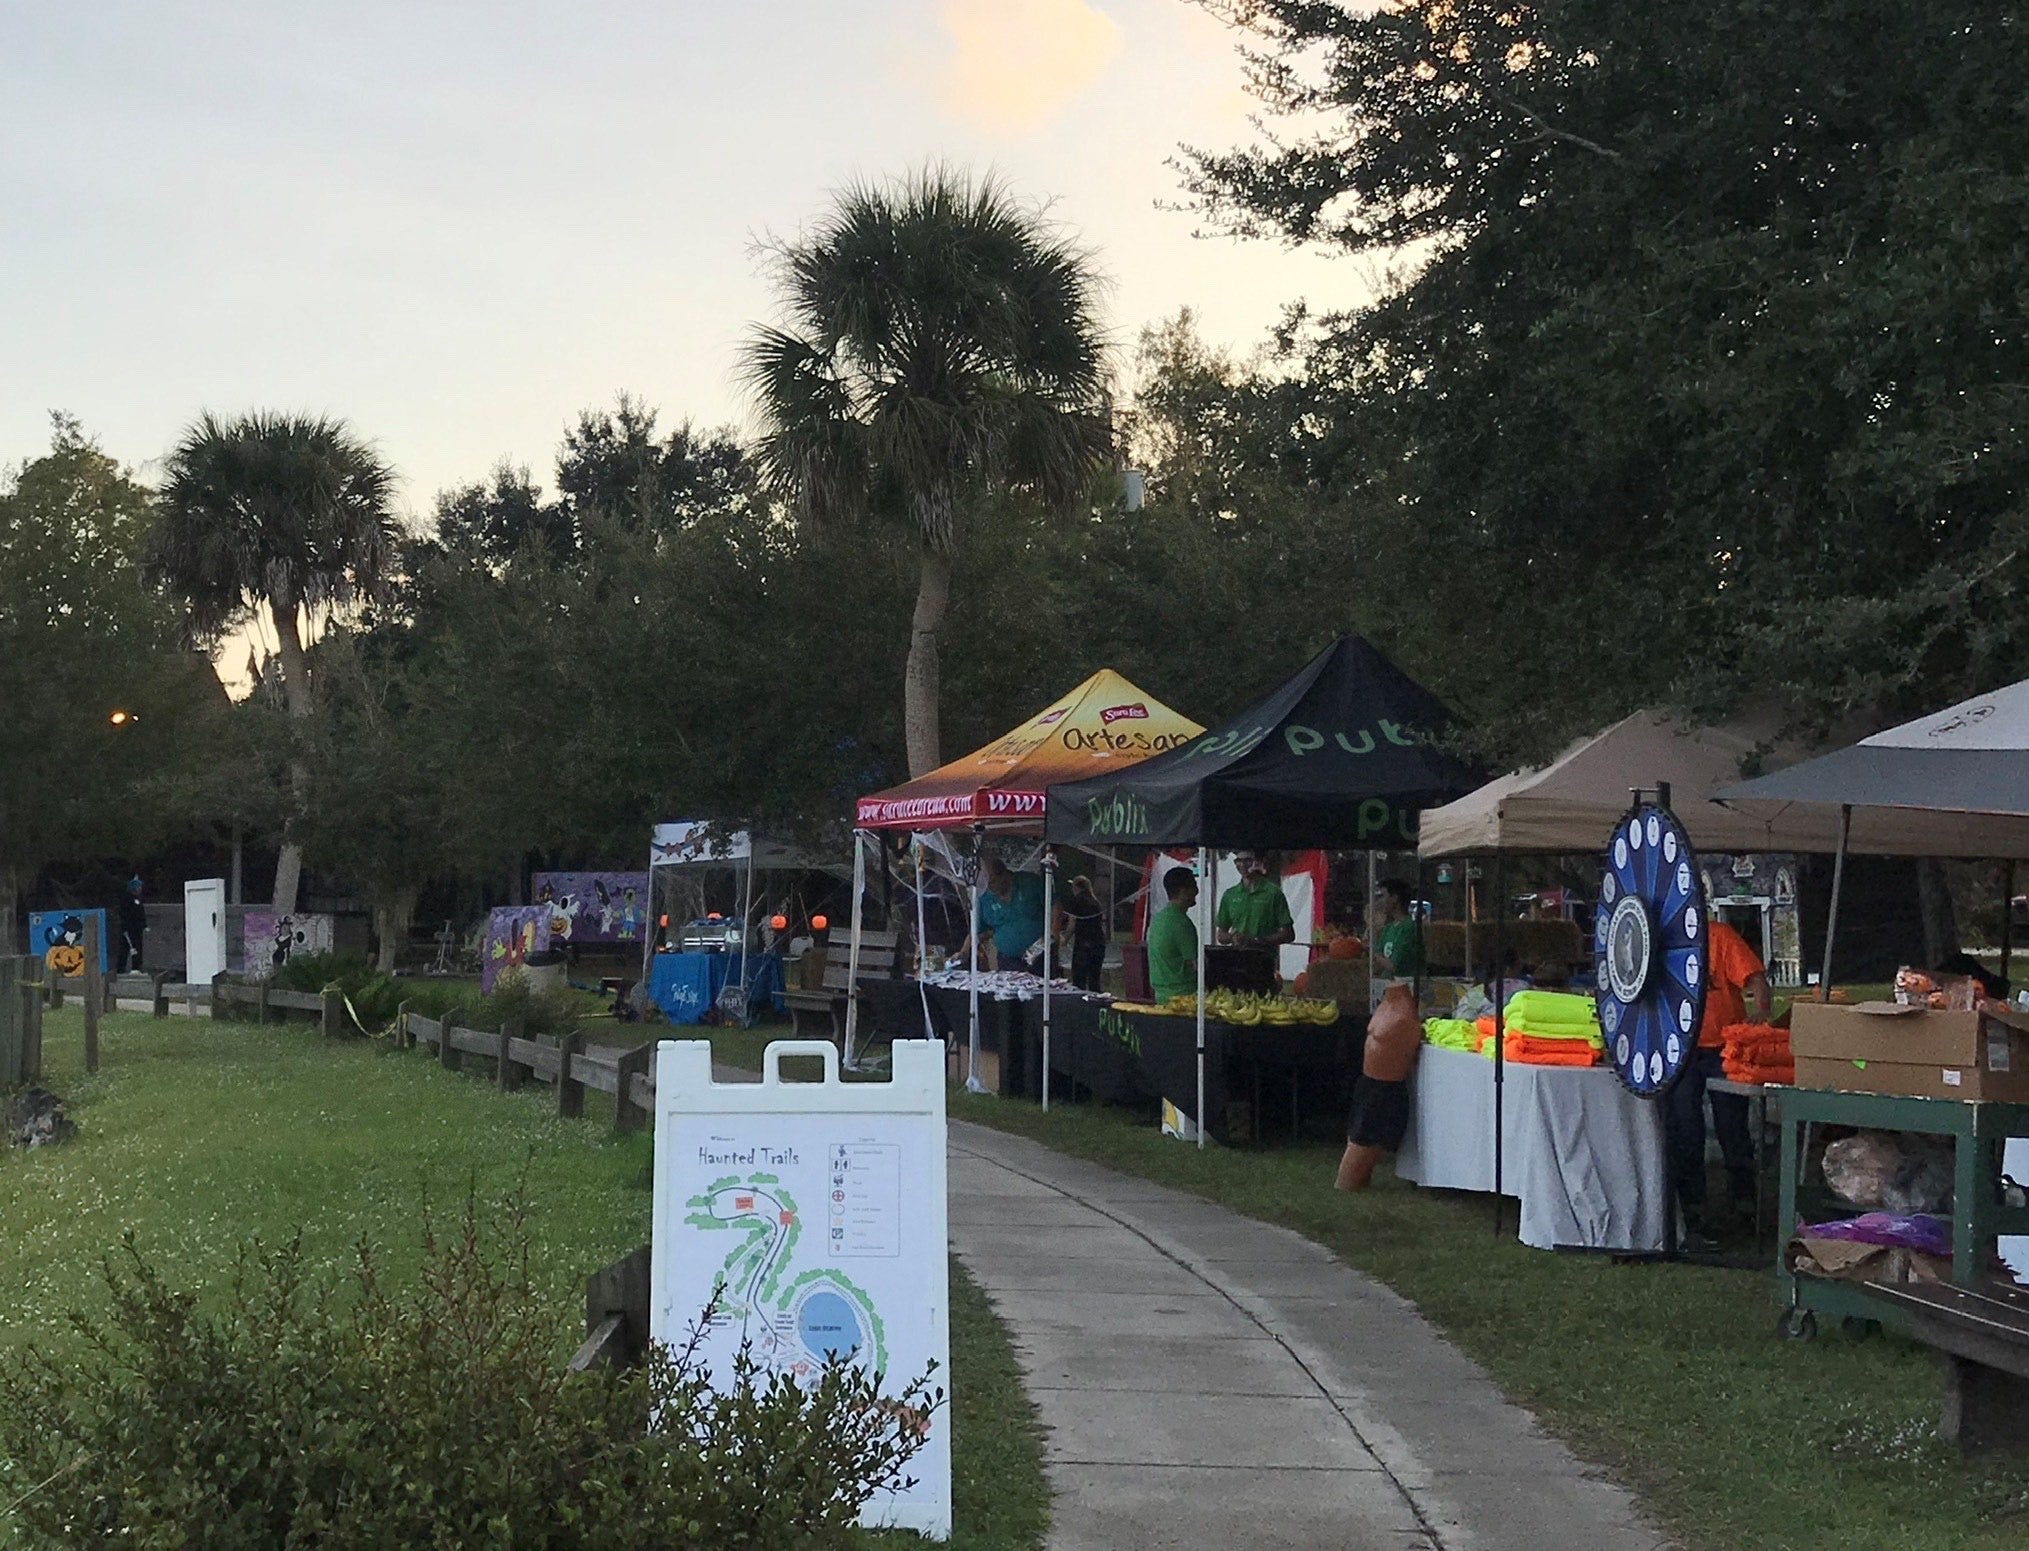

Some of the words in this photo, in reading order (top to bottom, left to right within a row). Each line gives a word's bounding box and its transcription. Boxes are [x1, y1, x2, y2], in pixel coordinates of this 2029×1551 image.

[1104, 708, 1128, 721] Sara
[1087, 793, 1149, 836] Publix
[698, 1146, 756, 1166] Haunted
[760, 1147, 800, 1166] Trails
